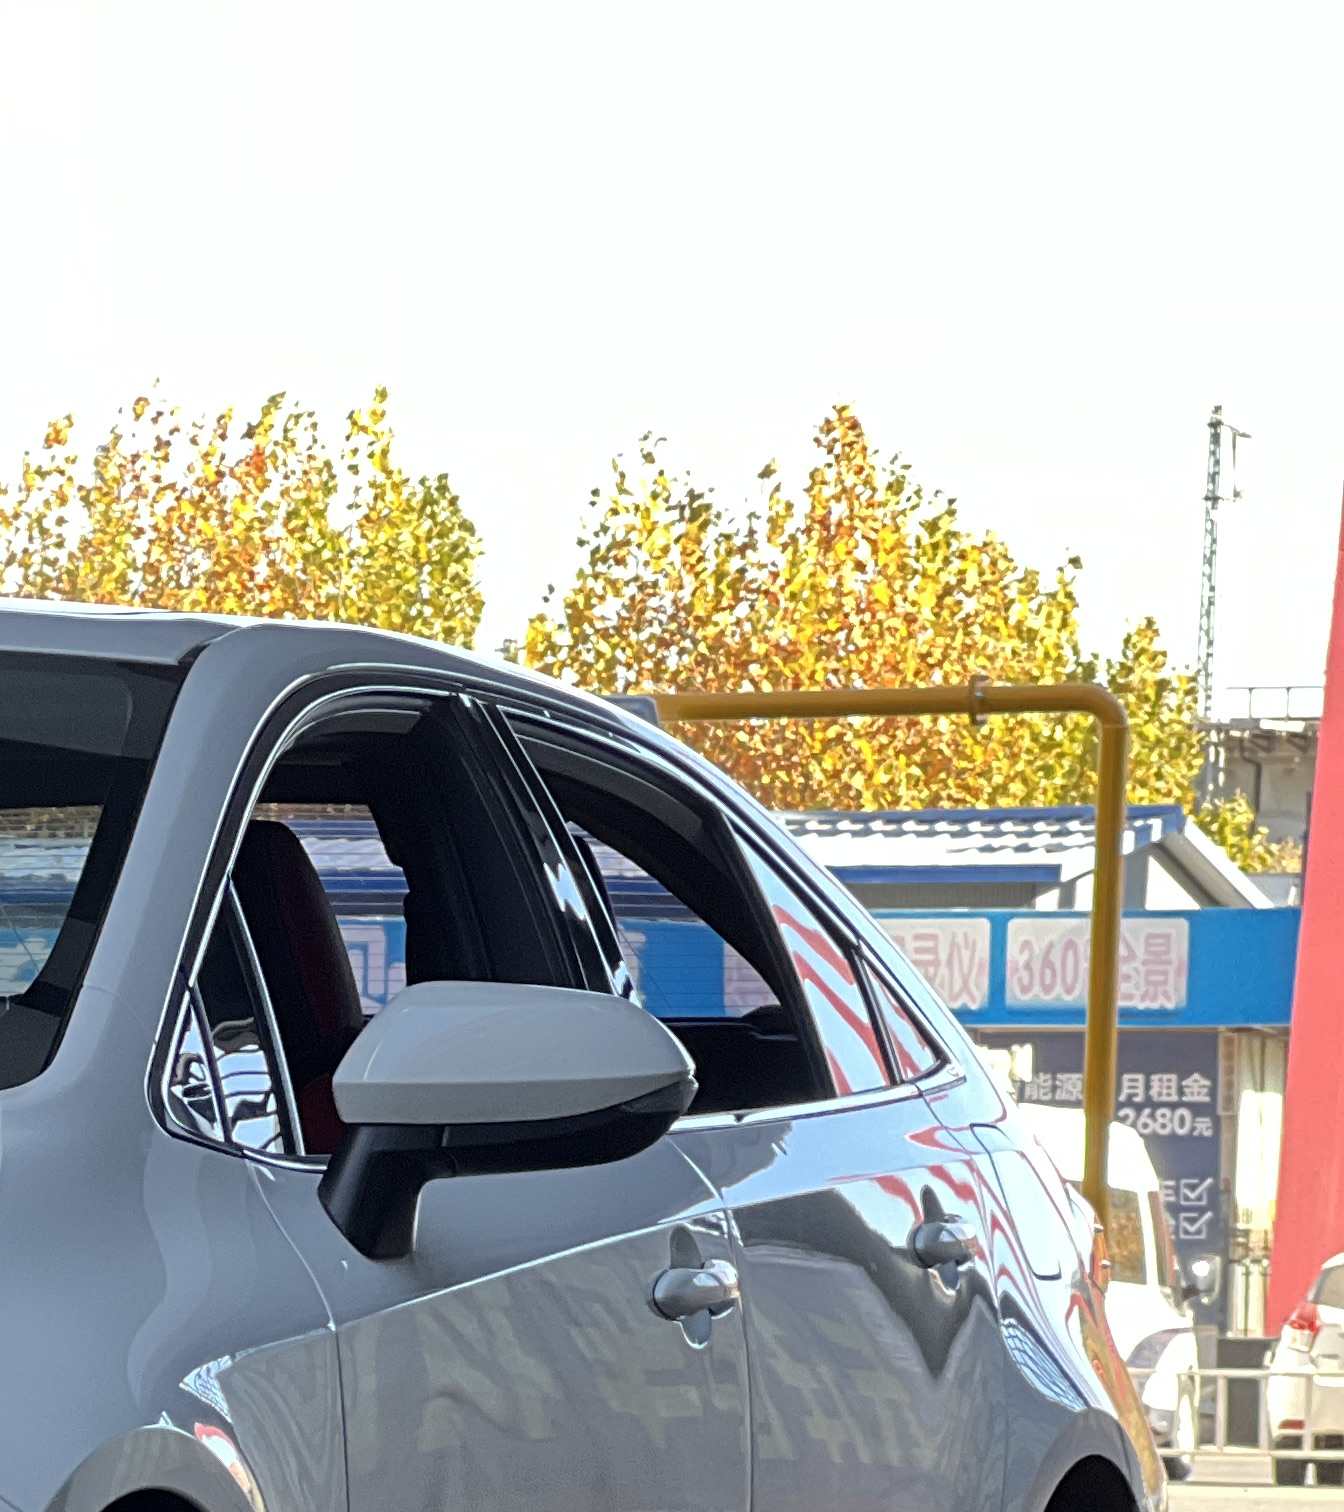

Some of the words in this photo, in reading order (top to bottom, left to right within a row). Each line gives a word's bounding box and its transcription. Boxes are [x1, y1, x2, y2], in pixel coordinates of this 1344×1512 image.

[1014, 1072, 1083, 1101] 能源
[1118, 1072, 1211, 1102] 月租金
